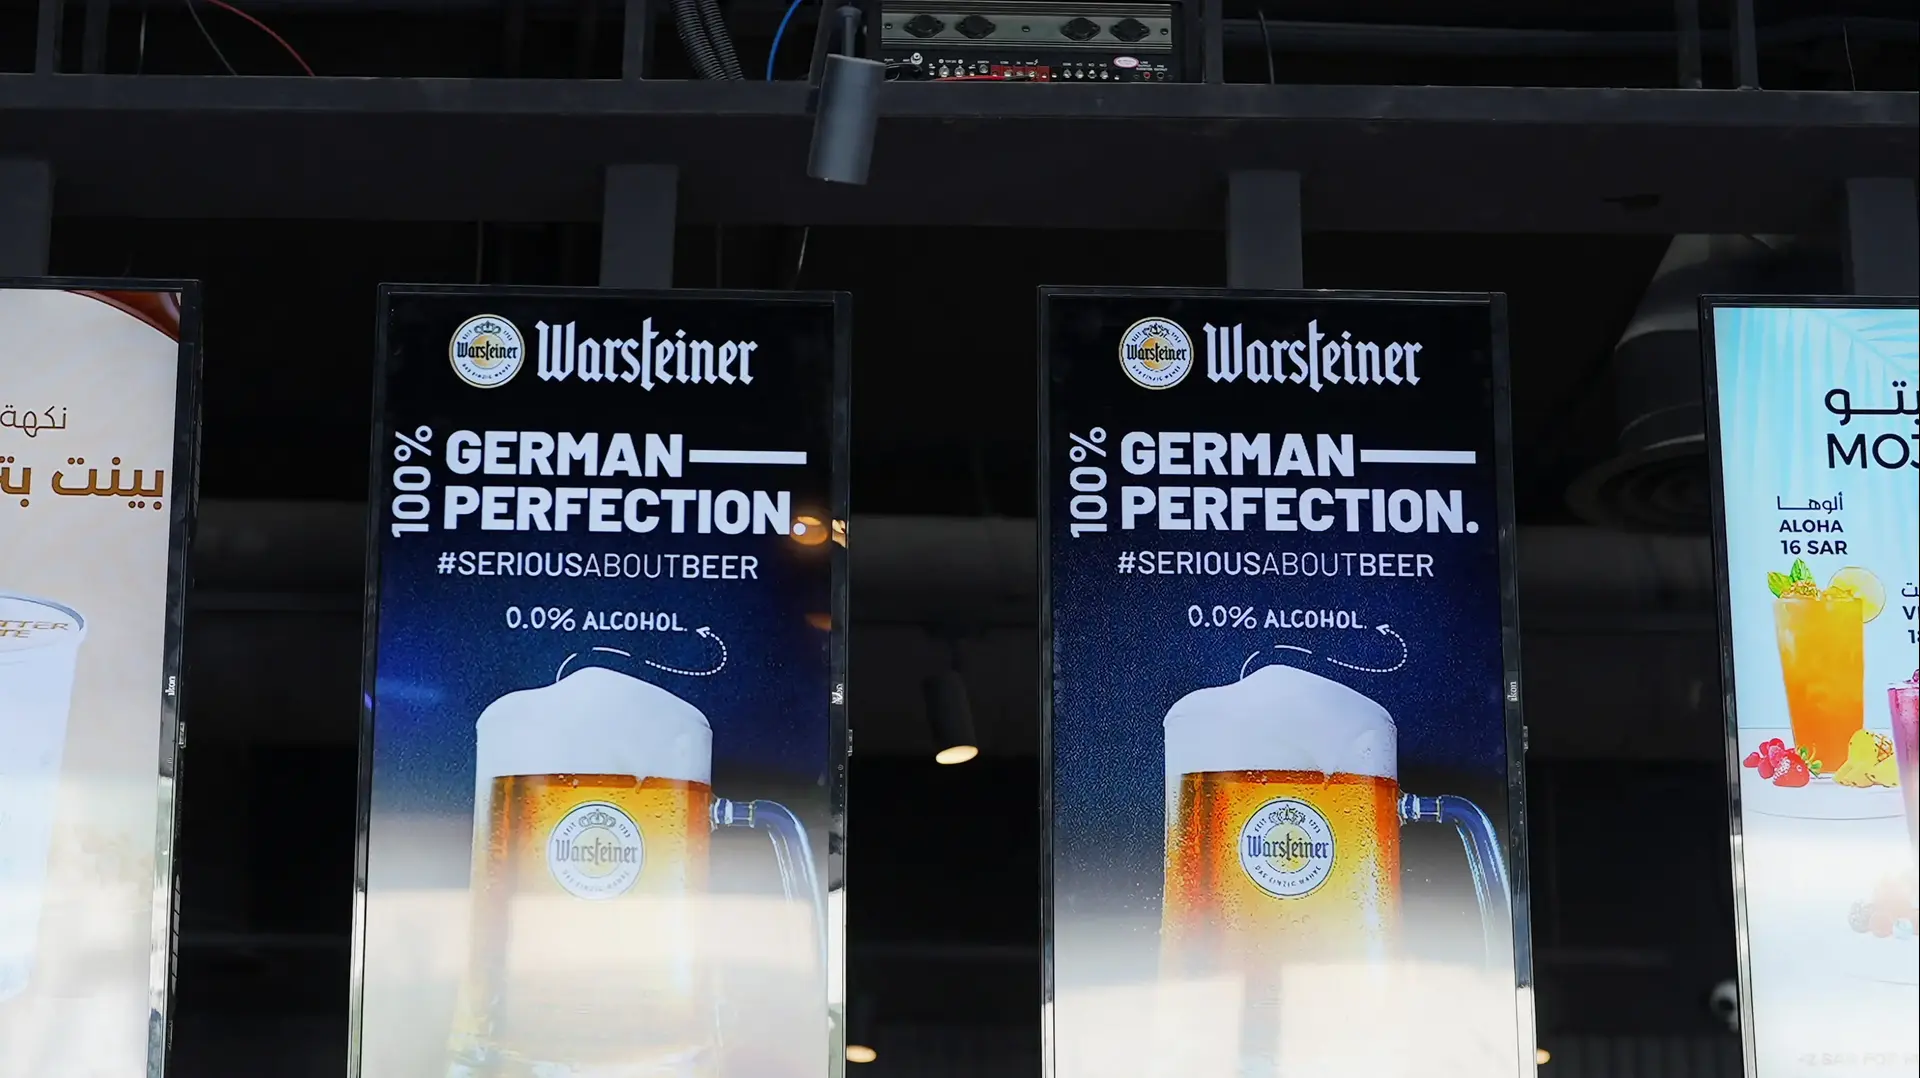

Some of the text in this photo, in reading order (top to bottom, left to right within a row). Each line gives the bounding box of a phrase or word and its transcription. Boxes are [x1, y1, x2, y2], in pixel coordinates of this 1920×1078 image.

[457, 340, 519, 361] Warsteiner
[535, 317, 759, 392] Warsteiner
[1126, 342, 1187, 363] Warsteiner
[1202, 319, 1423, 393] Warsteiner
[0, 404, 67, 438] نكهة
[445, 430, 683, 477] GERMAN
[1120, 431, 1355, 477] GERMAN
[51, 456, 165, 510] بينت
[391, 425, 433, 538] 100%
[1070, 426, 1108, 538] 100%
[443, 486, 806, 535] PERFECTION.
[1121, 486, 1479, 534] PERFECTION.
[1779, 519, 1844, 533] ALOHA
[1117, 550, 1434, 577] #SERIOUSABOUTBEER
[1780, 540, 1848, 555] 16 SAR
[437, 550, 759, 580] #SERIOUSABOUTBEER
[506, 606, 576, 631] 0.0%
[1188, 604, 1257, 629] 0.0%
[556, 837, 638, 866] Warsteiner
[1246, 833, 1329, 861] Warsteiner
